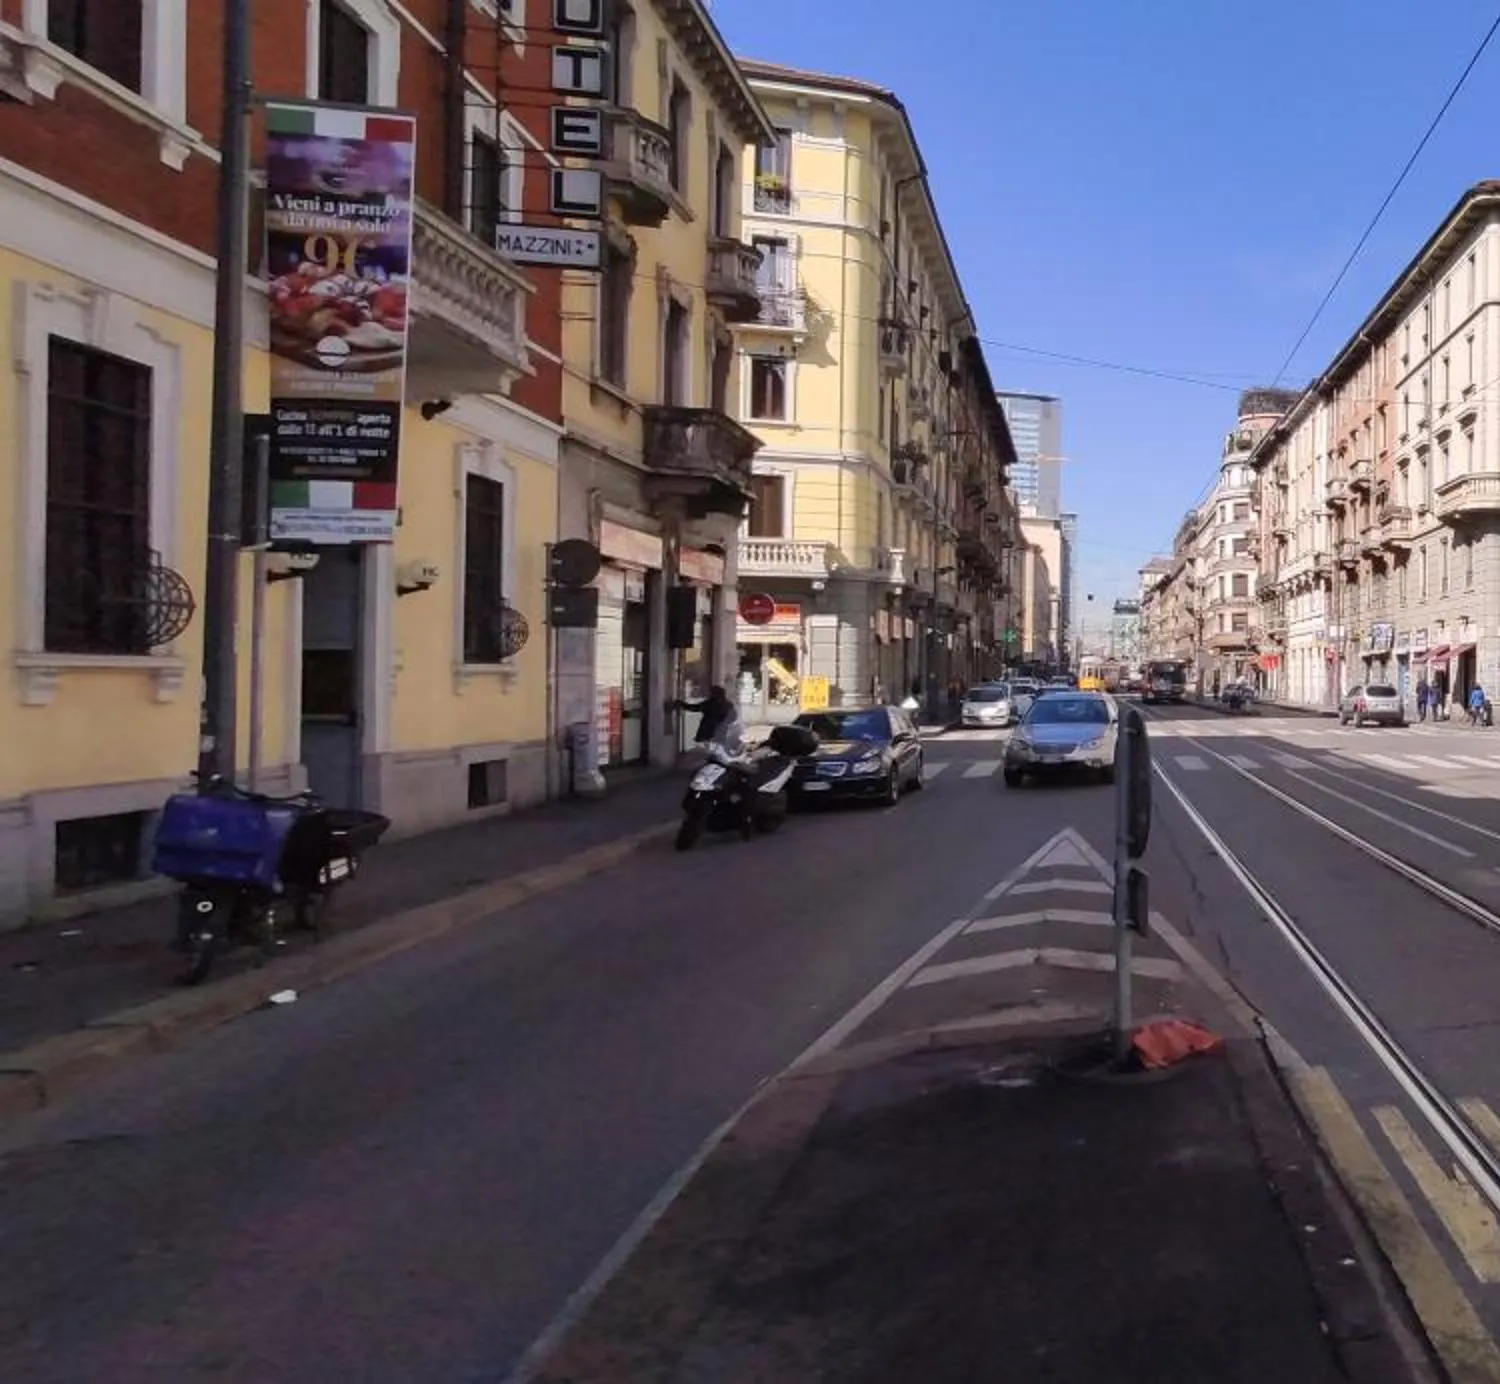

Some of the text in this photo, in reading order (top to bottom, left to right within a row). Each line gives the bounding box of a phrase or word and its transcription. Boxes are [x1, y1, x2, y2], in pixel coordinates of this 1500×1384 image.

[273, 193, 401, 219] Vieni a pranzo
[498, 234, 572, 255] MAZZINI
